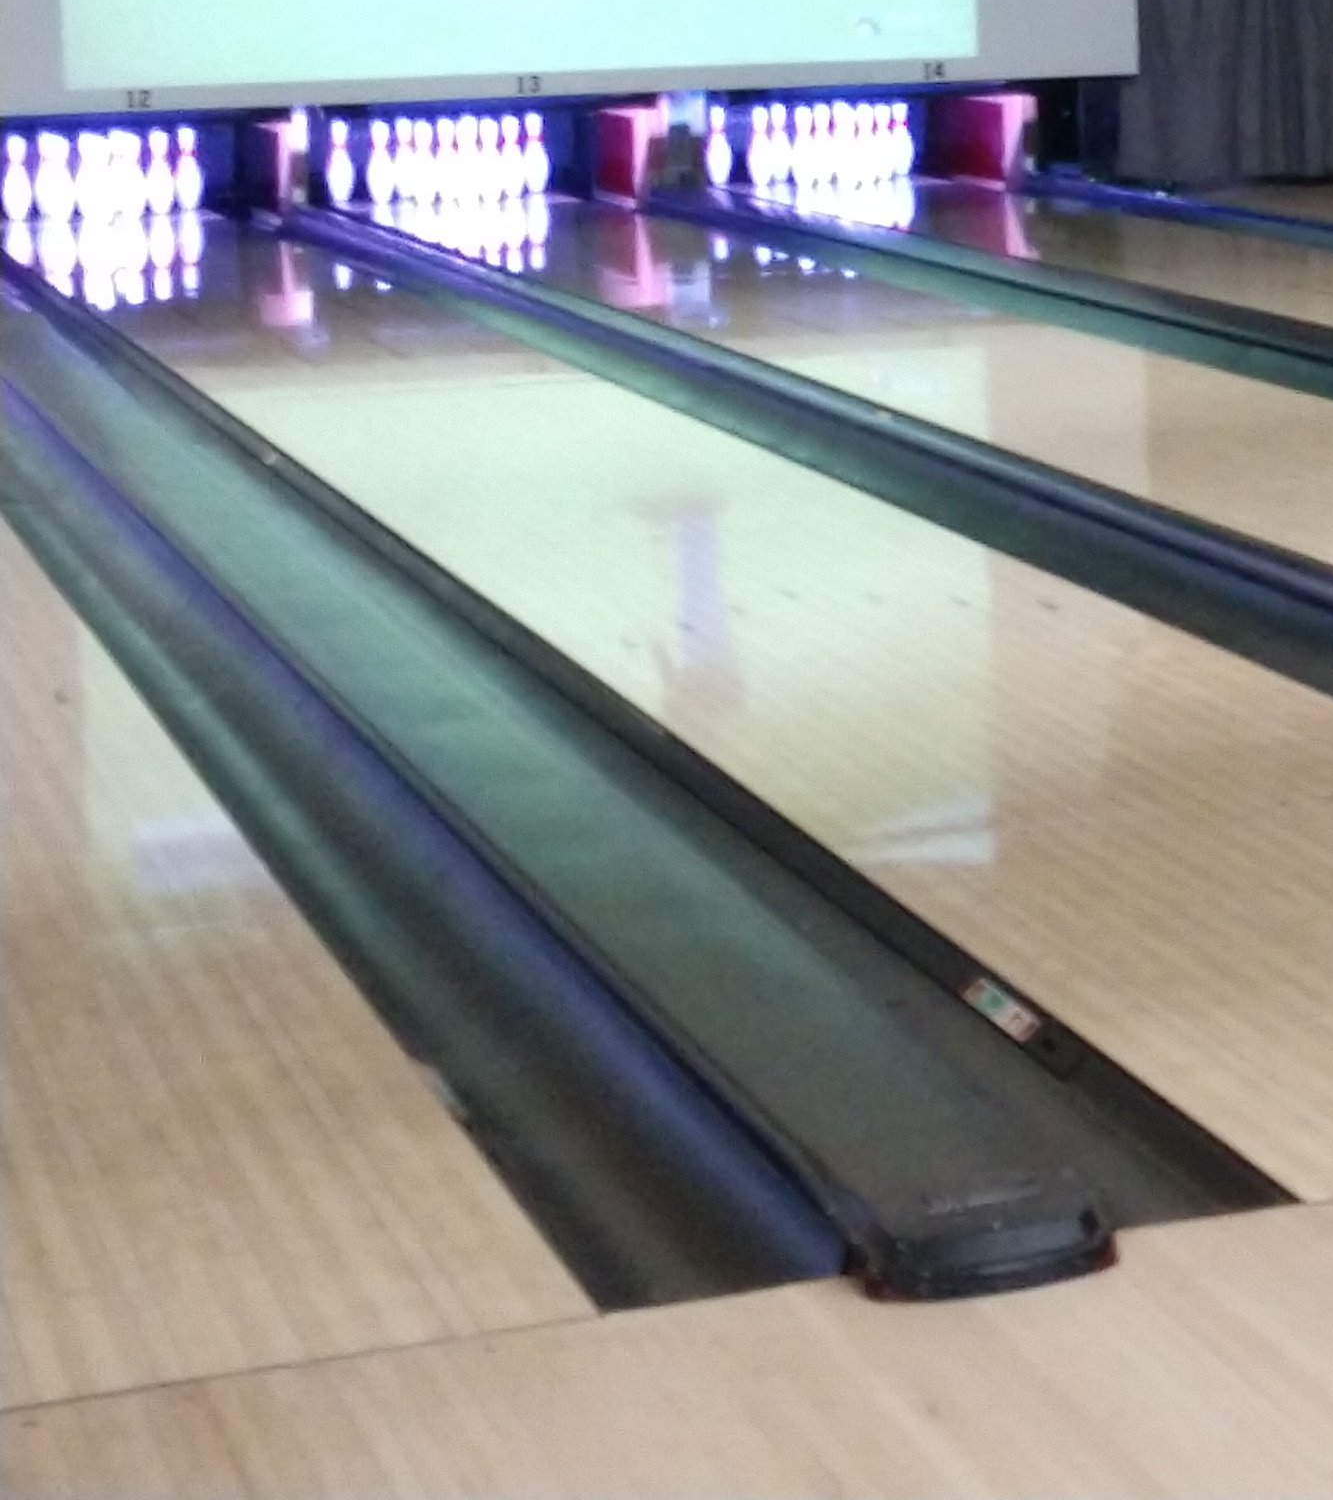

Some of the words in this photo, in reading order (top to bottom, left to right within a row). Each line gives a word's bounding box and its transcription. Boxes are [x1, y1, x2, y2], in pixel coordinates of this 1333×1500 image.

[924, 61, 945, 80] 14
[517, 75, 541, 95] 13
[127, 89, 151, 108] 12
